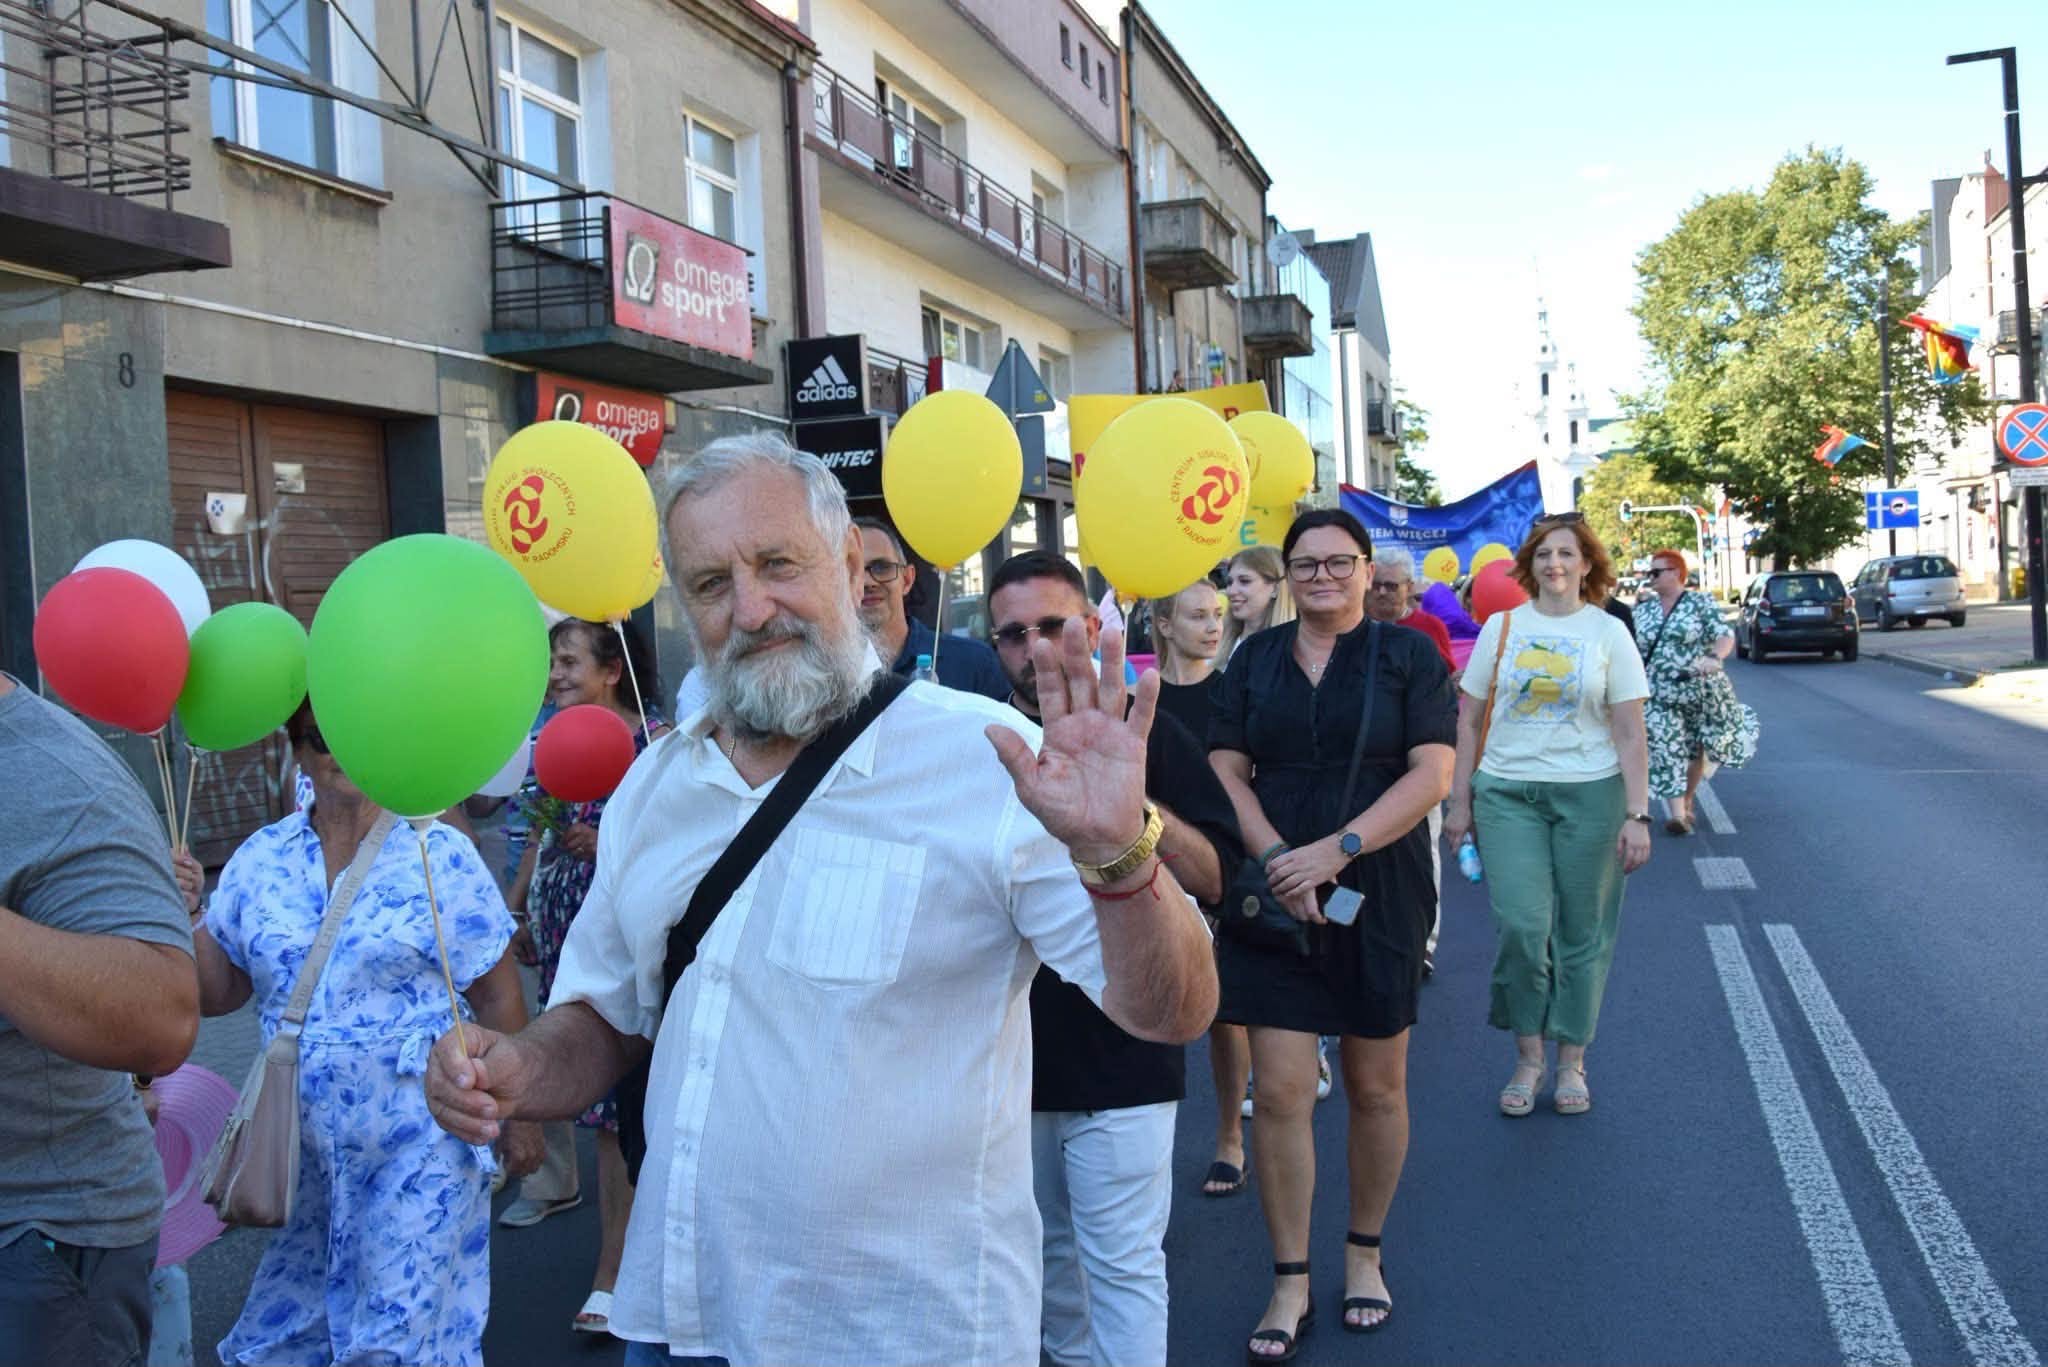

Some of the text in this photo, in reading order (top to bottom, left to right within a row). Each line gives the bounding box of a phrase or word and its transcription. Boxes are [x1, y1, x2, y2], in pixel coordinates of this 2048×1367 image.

[674, 257, 747, 305] omega
[662, 281, 725, 322] sport
[119, 352, 135, 388] 8
[796, 385, 857, 402] adidas
[597, 401, 659, 435] omega
[585, 421, 638, 448] ort
[821, 449, 874, 468] HI-TEC
[1366, 527, 1394, 539] IEM
